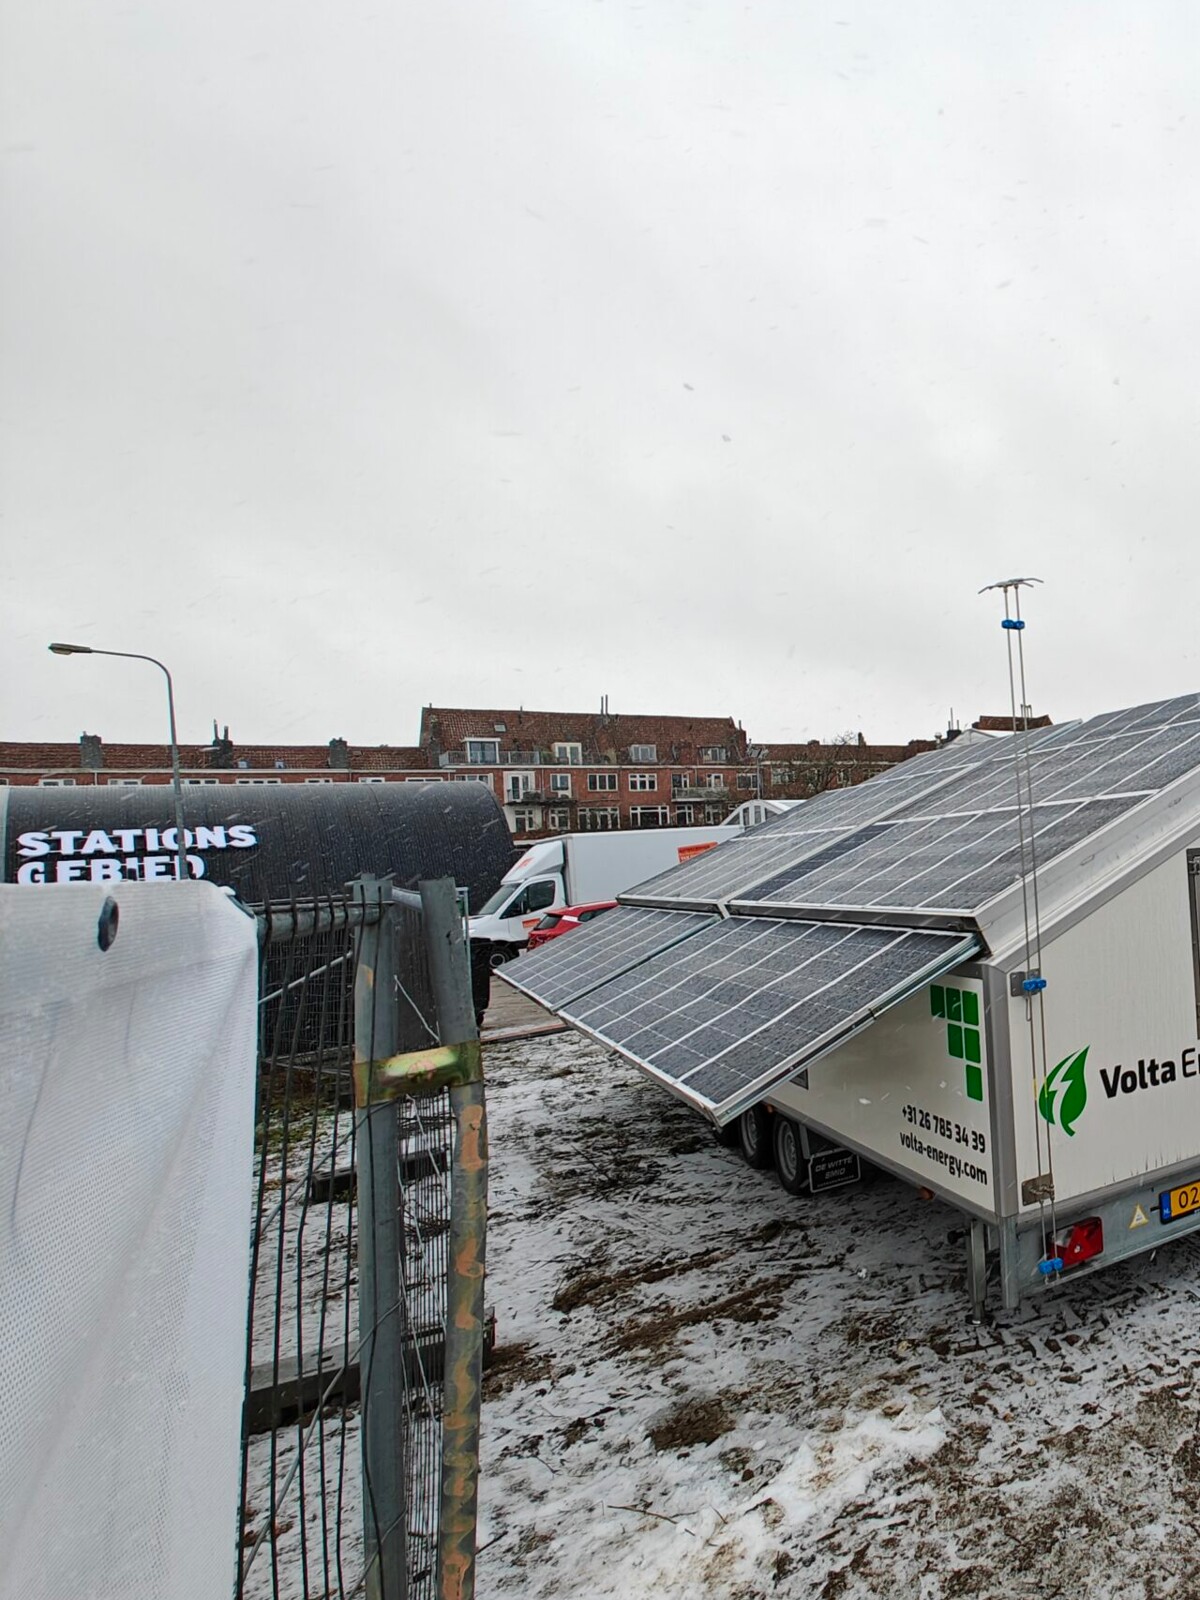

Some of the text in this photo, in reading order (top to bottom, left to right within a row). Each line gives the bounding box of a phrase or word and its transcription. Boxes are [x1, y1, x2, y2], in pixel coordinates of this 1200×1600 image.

[17, 824, 257, 857] STATIONS
[16, 854, 206, 885] GEBIED
[1099, 1058, 1177, 1099] Volta
[902, 1104, 987, 1154] +31 26 785 34 39
[899, 1132, 988, 1186] volta-energy.com
